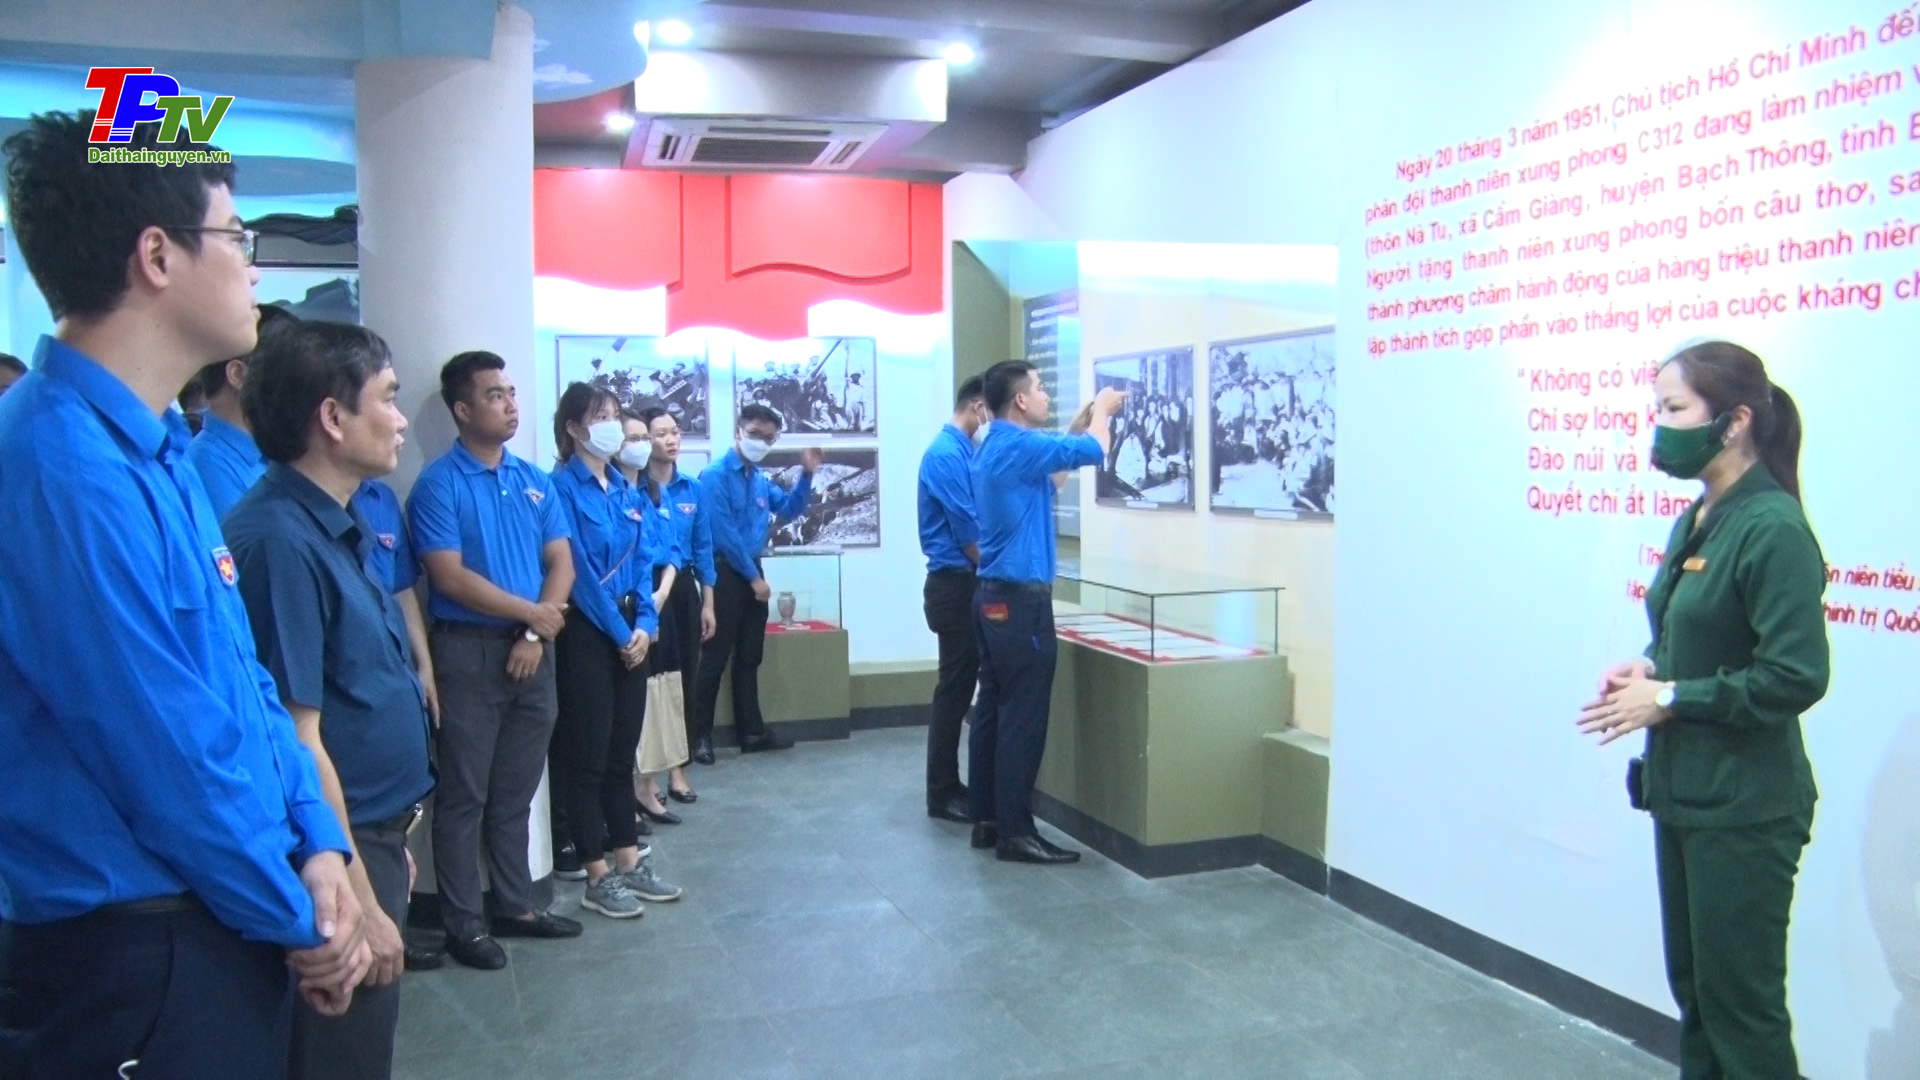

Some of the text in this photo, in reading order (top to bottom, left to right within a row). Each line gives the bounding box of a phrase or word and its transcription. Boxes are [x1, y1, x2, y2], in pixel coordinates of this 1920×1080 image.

[1435, 147, 1452, 169] 20
[1457, 136, 1502, 162] tháng
[1508, 126, 1518, 147] 3
[1521, 119, 1558, 145] năm
[1612, 86, 1652, 118] Chủ
[1659, 75, 1700, 111] tịch
[1708, 58, 1740, 91] Hồ
[1749, 44, 1792, 79] Chí
[1799, 25, 1867, 67] Minh
[1877, 1, 1920, 43] đế
[1430, 178, 1473, 206] thanh
[1477, 169, 1511, 194] niên
[1517, 160, 1561, 183] xung
[1567, 142, 1628, 177] phong
[1693, 109, 1752, 139] đang
[1761, 93, 1807, 123] làm
[1814, 70, 1903, 109] nhiệm
[1601, 172, 1665, 206] huyện
[1678, 154, 1739, 190] Bạch
[1840, 119, 1896, 154] tỉnh
[1462, 245, 1509, 271] thanh
[1517, 235, 1555, 261] niên
[1562, 229, 1610, 253] xung
[1619, 215, 1688, 247] phong
[1754, 189, 1801, 219] câu
[1368, 299, 1404, 321] thành
[1517, 276, 1558, 300] hành
[1563, 269, 1609, 298] động
[1616, 259, 1651, 286] của
[1657, 254, 1711, 282] hàng
[1718, 242, 1769, 275] triệu
[1778, 228, 1853, 264] thanh
[1391, 330, 1429, 353] thành
[1433, 325, 1459, 348] tích
[1463, 322, 1494, 350] góp
[1546, 311, 1578, 335] vào
[1647, 299, 1673, 330] lợi
[1679, 294, 1719, 321] của
[1727, 287, 1788, 320] cuộc
[1797, 277, 1882, 310] kháng
[1598, 362, 1623, 389] có
[1528, 446, 1564, 471] Đào
[1574, 446, 1604, 472] núi
[1614, 445, 1638, 472] và
[1562, 411, 1589, 438] sợ
[1593, 405, 1638, 437] lòng
[1527, 480, 1583, 517] Quyết
[1588, 488, 1620, 513] chí
